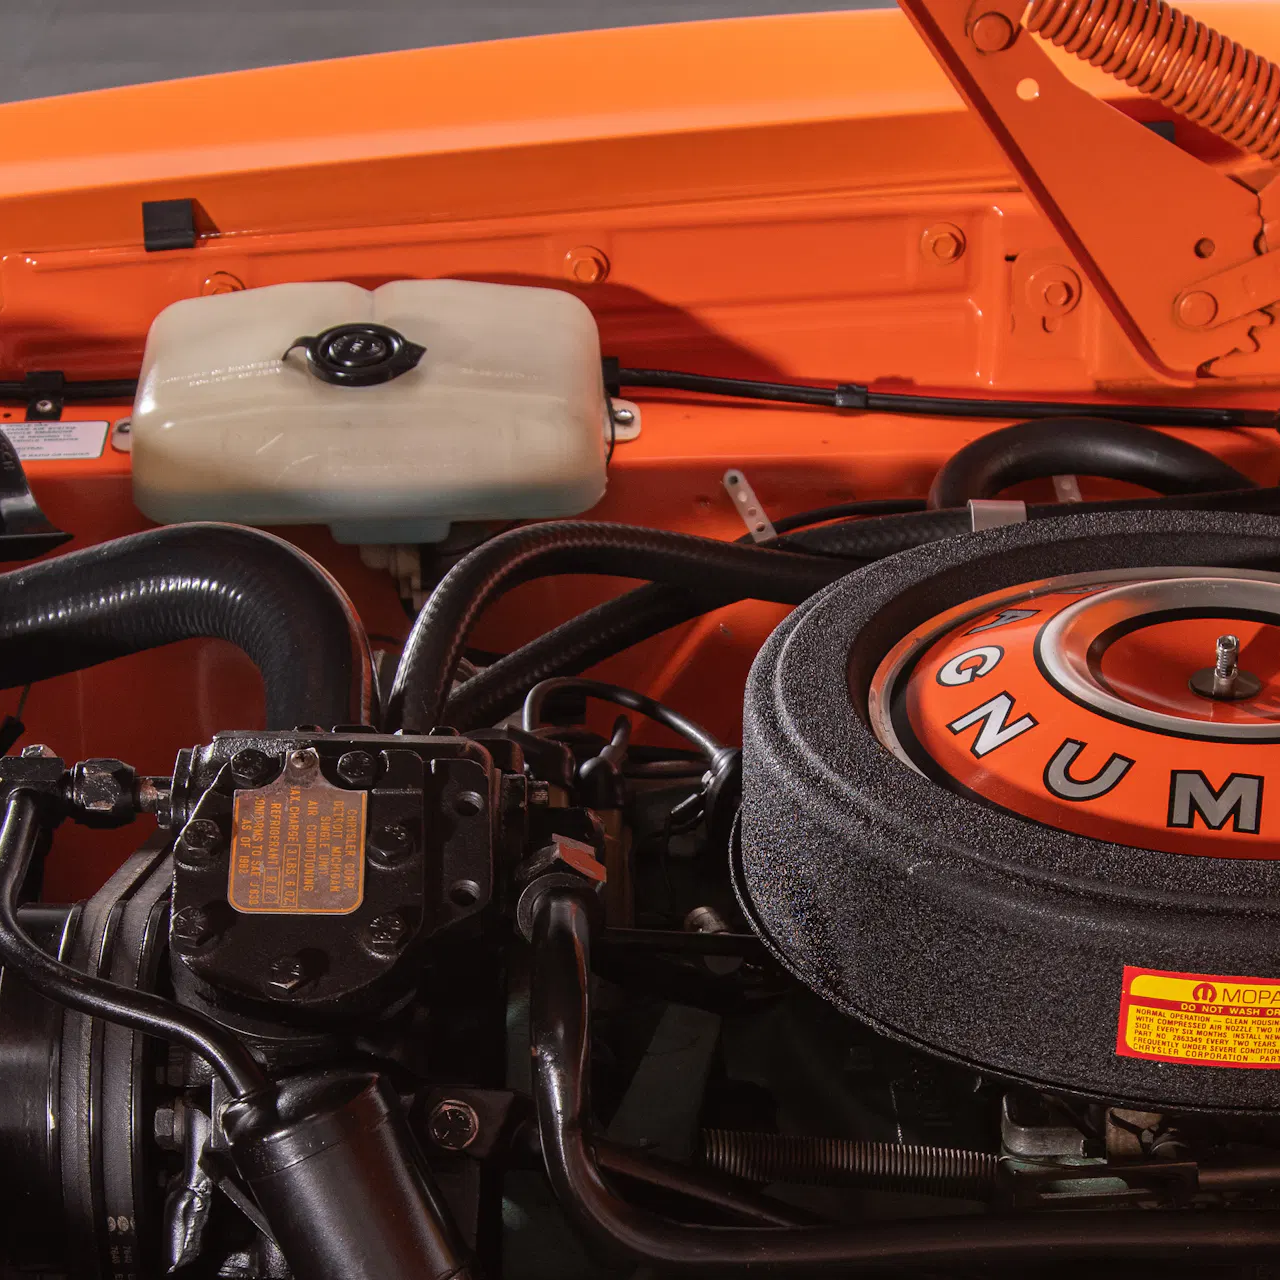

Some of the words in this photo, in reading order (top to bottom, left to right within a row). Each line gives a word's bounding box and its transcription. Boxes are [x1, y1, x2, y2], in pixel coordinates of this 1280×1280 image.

[936, 585, 1265, 834] AGNUM
[306, 799, 318, 816] AIR
[240, 818, 252, 830] AS
[287, 805, 300, 841] CHARGE
[330, 800, 344, 839] DETROIT
[267, 802, 282, 865] REFRIGERANT
[318, 815, 331, 848] SINGLE
[344, 809, 358, 856] CHRYSLER
[239, 836, 251, 848] OF
[251, 845, 262, 856] TO
[302, 824, 317, 891] CONDITIONING
[317, 854, 329, 875] UNIT
[249, 860, 261, 877] SAE
[328, 846, 342, 892] MICHIGAN
[1135, 1007, 1167, 1018] NORMAL
[1169, 1012, 1210, 1022] OPERATION
[1225, 1017, 1248, 1025] CLEAN
[1180, 1002, 1196, 1011] DO
[1201, 1004, 1223, 1013] NOT
[1228, 1006, 1260, 1016] WASH
[1265, 1007, 1280, 1016] OR
[1134, 1015, 1154, 1023] WITH
[1156, 1018, 1207, 1029] COMPRESSED
[1224, 1024, 1252, 1032] NOZZLE
[1255, 1025, 1272, 1033] TWO
[1155, 1024, 1179, 1033] EVERY
[1232, 1032, 1261, 1040] INSTALL
[1132, 1042, 1179, 1055] CHRYSLER
[1133, 1036, 1179, 1048] FREQUENTLY
[1181, 1042, 1207, 1051] UNDER
[1209, 1044, 1239, 1053] SEVERE
[1205, 1037, 1229, 1045] EVERY
